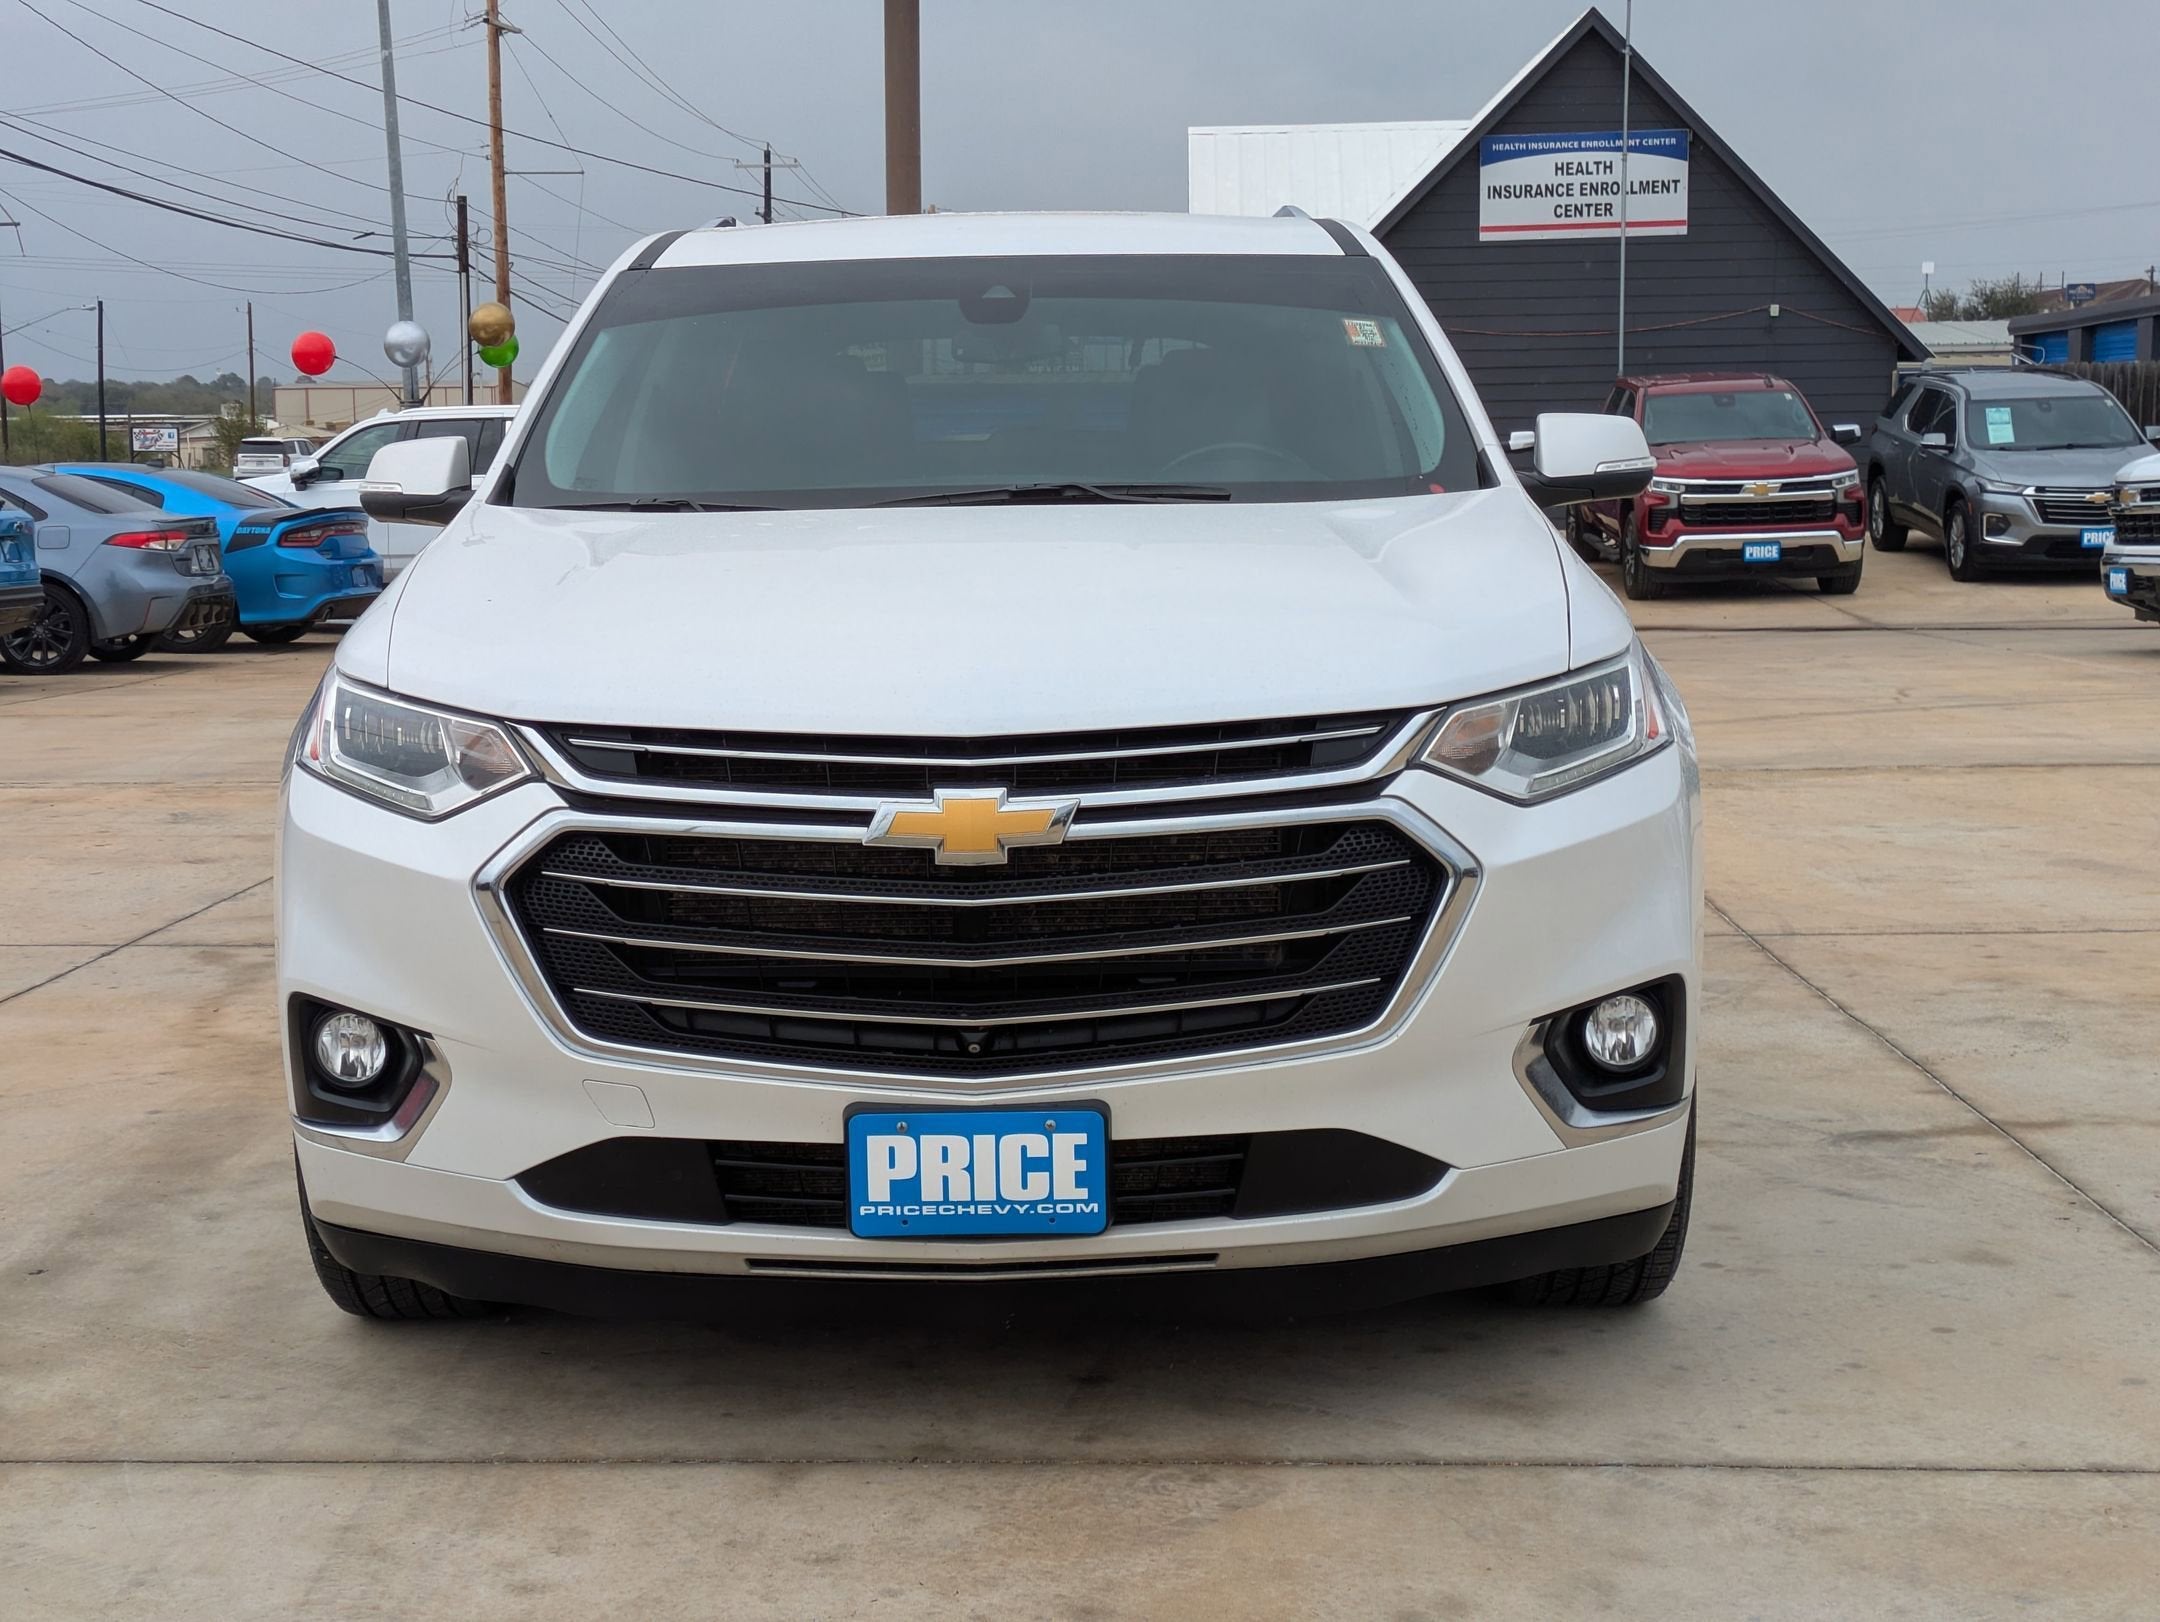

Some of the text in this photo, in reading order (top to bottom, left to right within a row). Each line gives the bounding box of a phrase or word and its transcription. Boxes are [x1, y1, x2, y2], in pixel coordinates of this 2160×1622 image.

[1492, 137, 1677, 151] HEALTH INSURANCE ENROLLMNT CENTER
[1554, 161, 1613, 176] HEALTH
[1487, 179, 1681, 200] INSURANCE ENROLMENT
[1554, 203, 1613, 218] CENTER
[2083, 531, 2115, 545] PRIC
[1745, 545, 1779, 559] PRICE
[866, 1133, 1089, 1202] PRICE
[860, 1203, 1099, 1216] PRICECHEVY.COM
